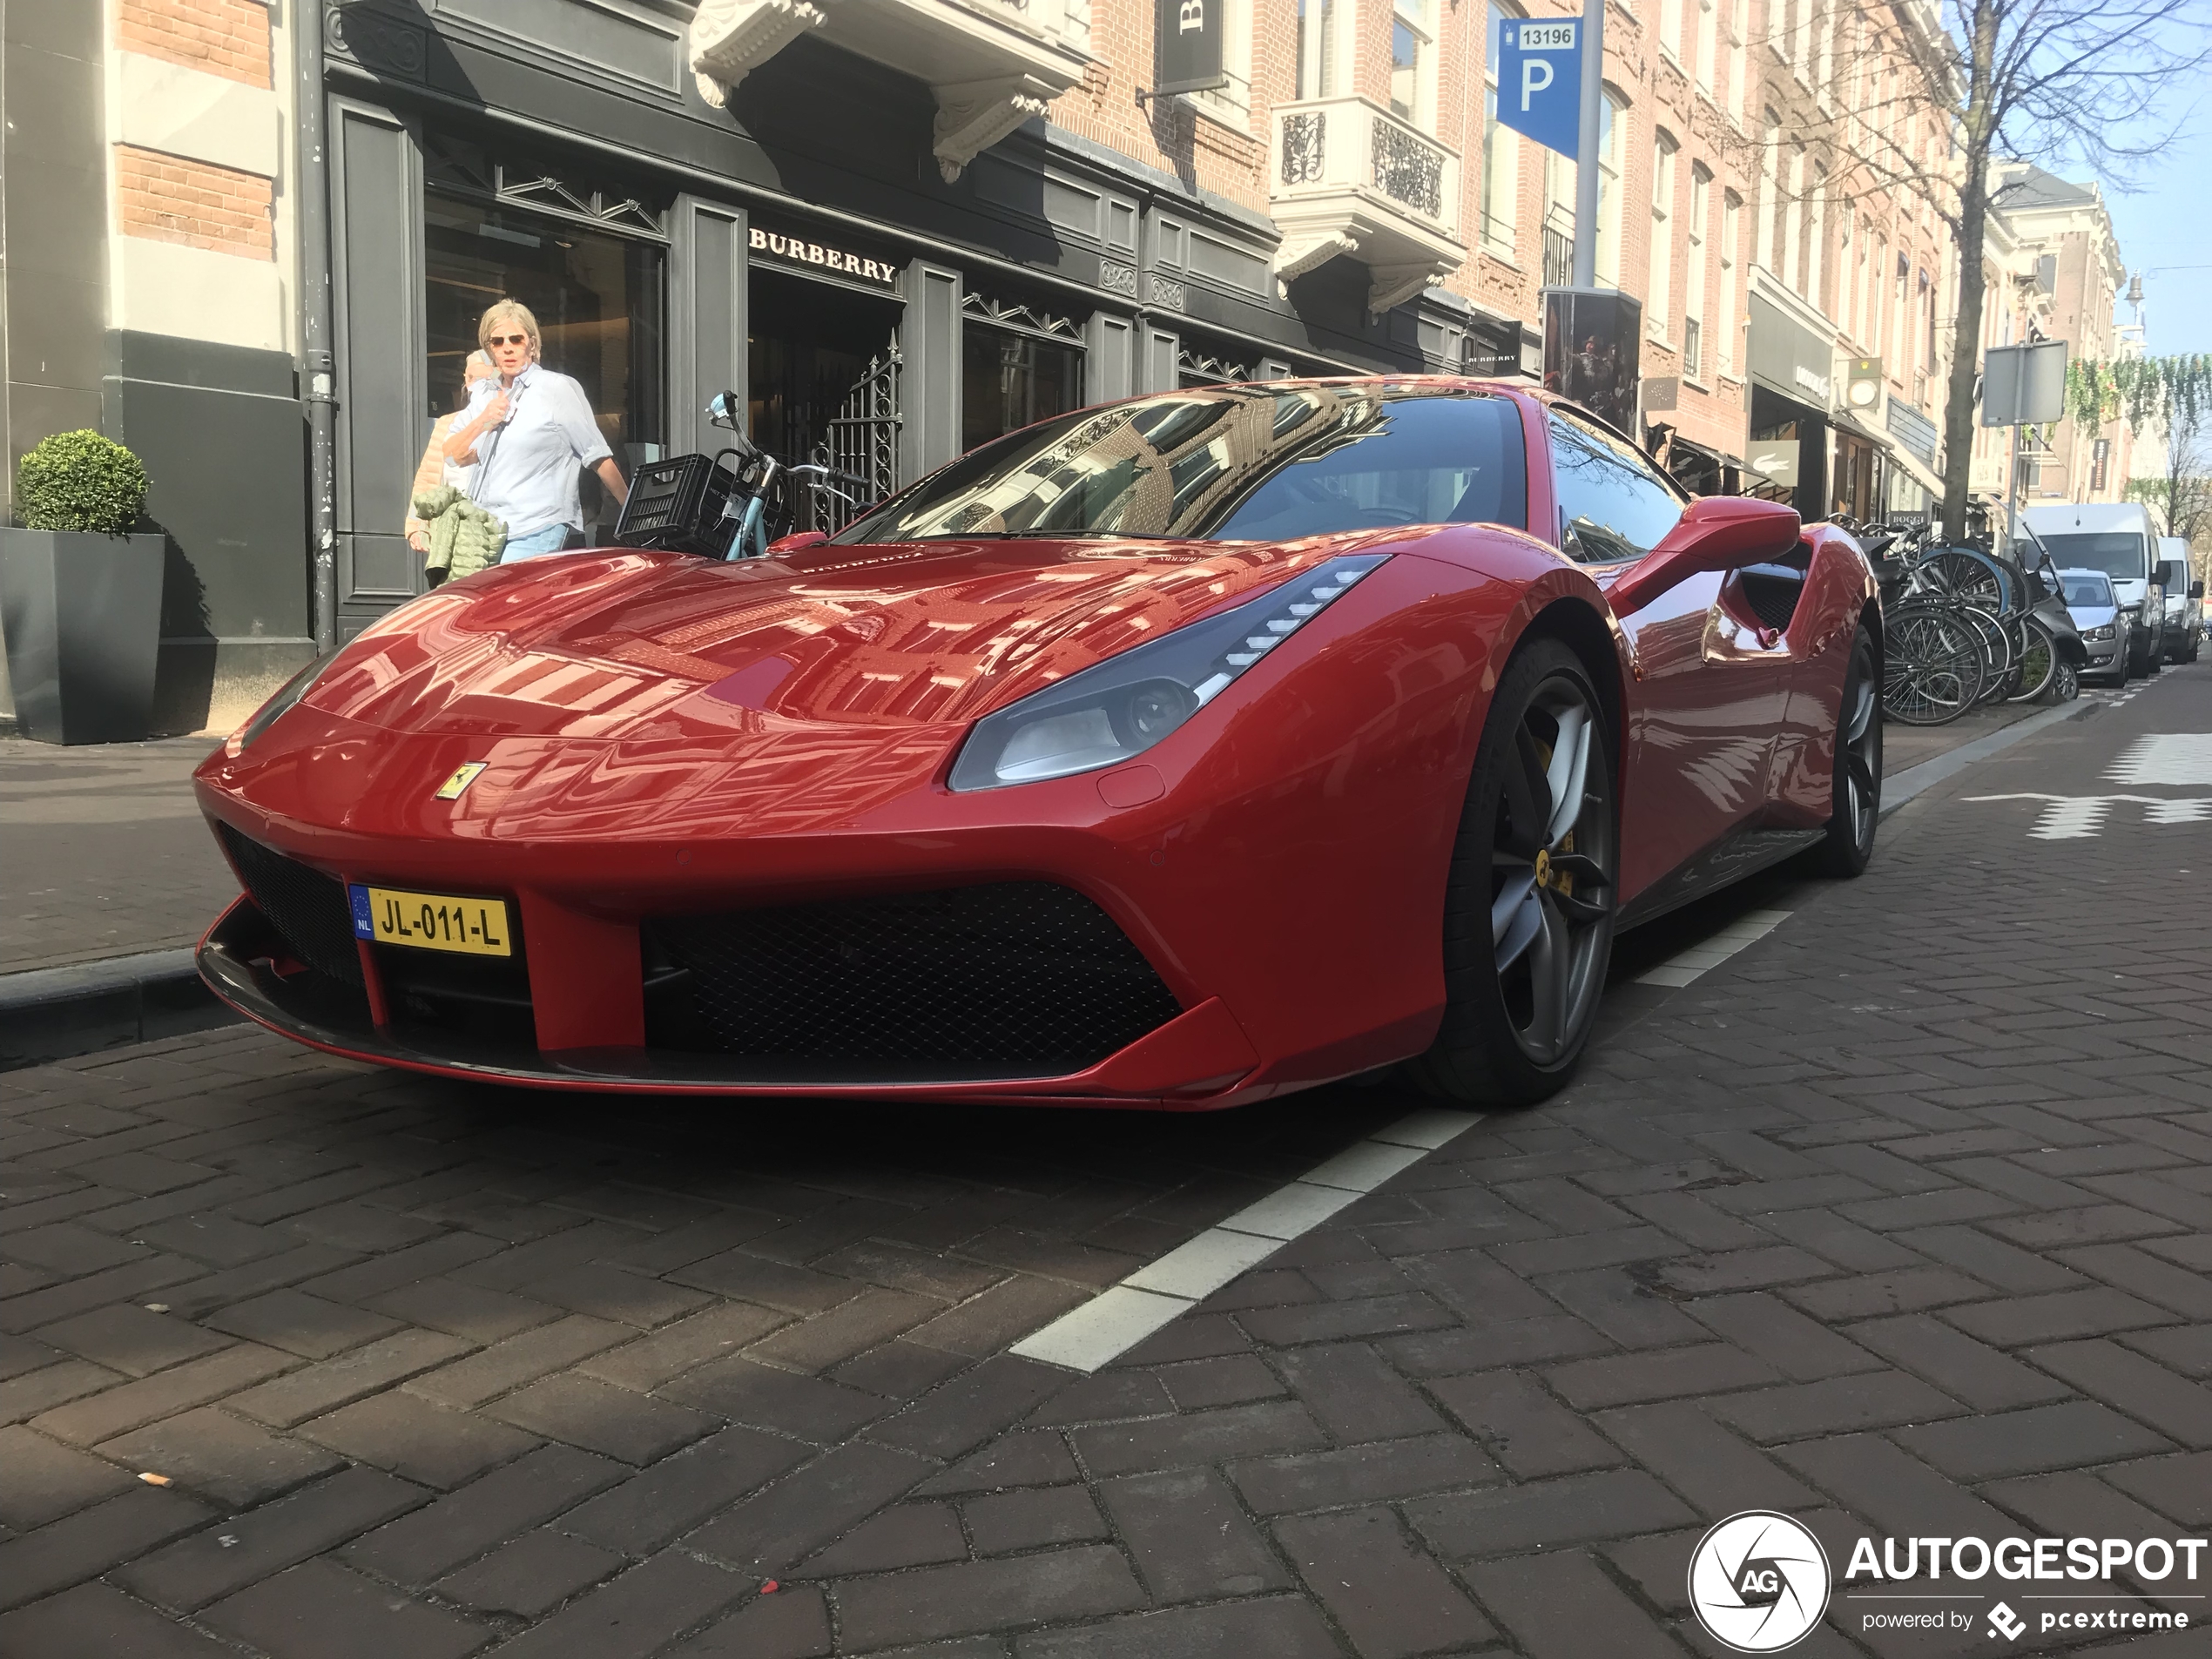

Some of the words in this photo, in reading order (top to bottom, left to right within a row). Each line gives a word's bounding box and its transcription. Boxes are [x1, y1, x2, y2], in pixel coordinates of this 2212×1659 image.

[1179, 0, 1203, 35] B
[1523, 29, 1571, 44] 13196
[1521, 58, 1554, 111] P
[748, 227, 896, 283] BURBERRY
[357, 919, 371, 931] NL
[381, 899, 501, 946] JL-011-L
